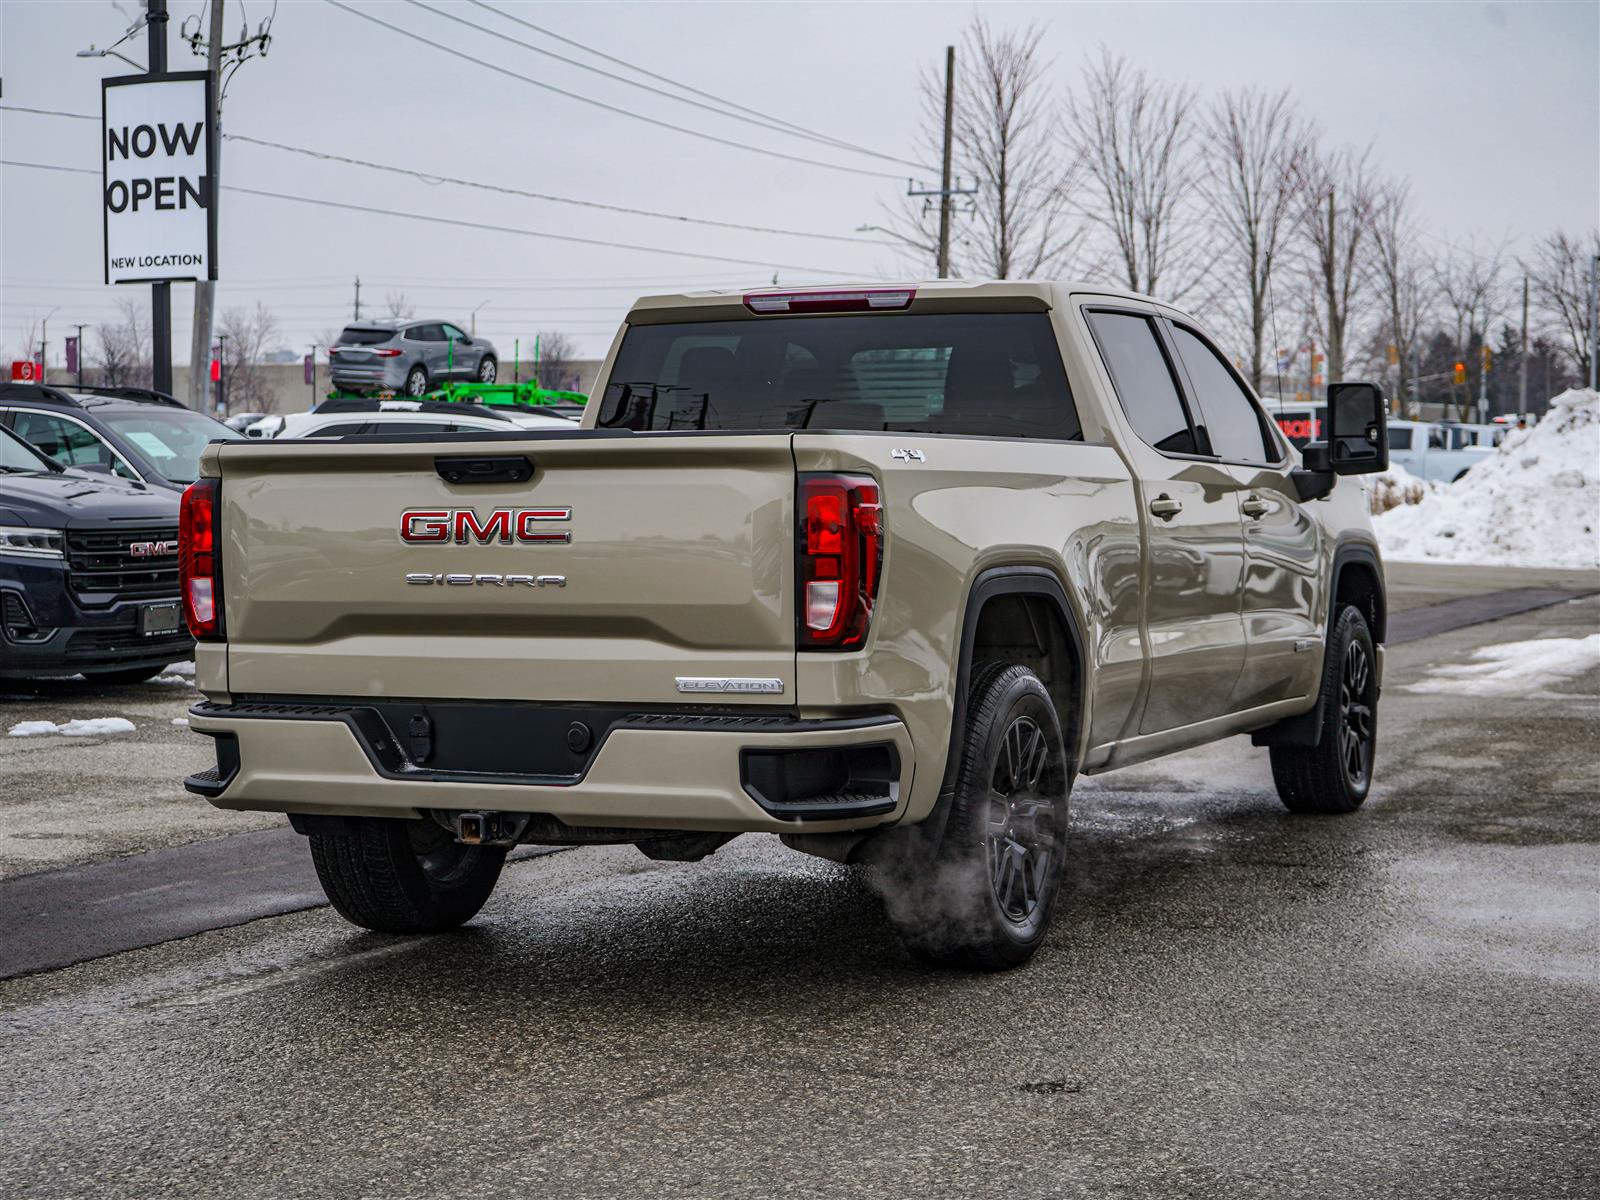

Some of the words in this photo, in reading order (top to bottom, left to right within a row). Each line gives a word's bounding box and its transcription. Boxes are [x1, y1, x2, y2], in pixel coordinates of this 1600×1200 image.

[108, 121, 204, 161] NOW
[106, 175, 208, 213] OPEN
[111, 256, 135, 268] NEW
[138, 254, 202, 267] LOCATION
[400, 508, 572, 545] GMC
[130, 541, 178, 557] GMC
[406, 573, 566, 587] SIERRA
[682, 680, 776, 690] ELEVATION
